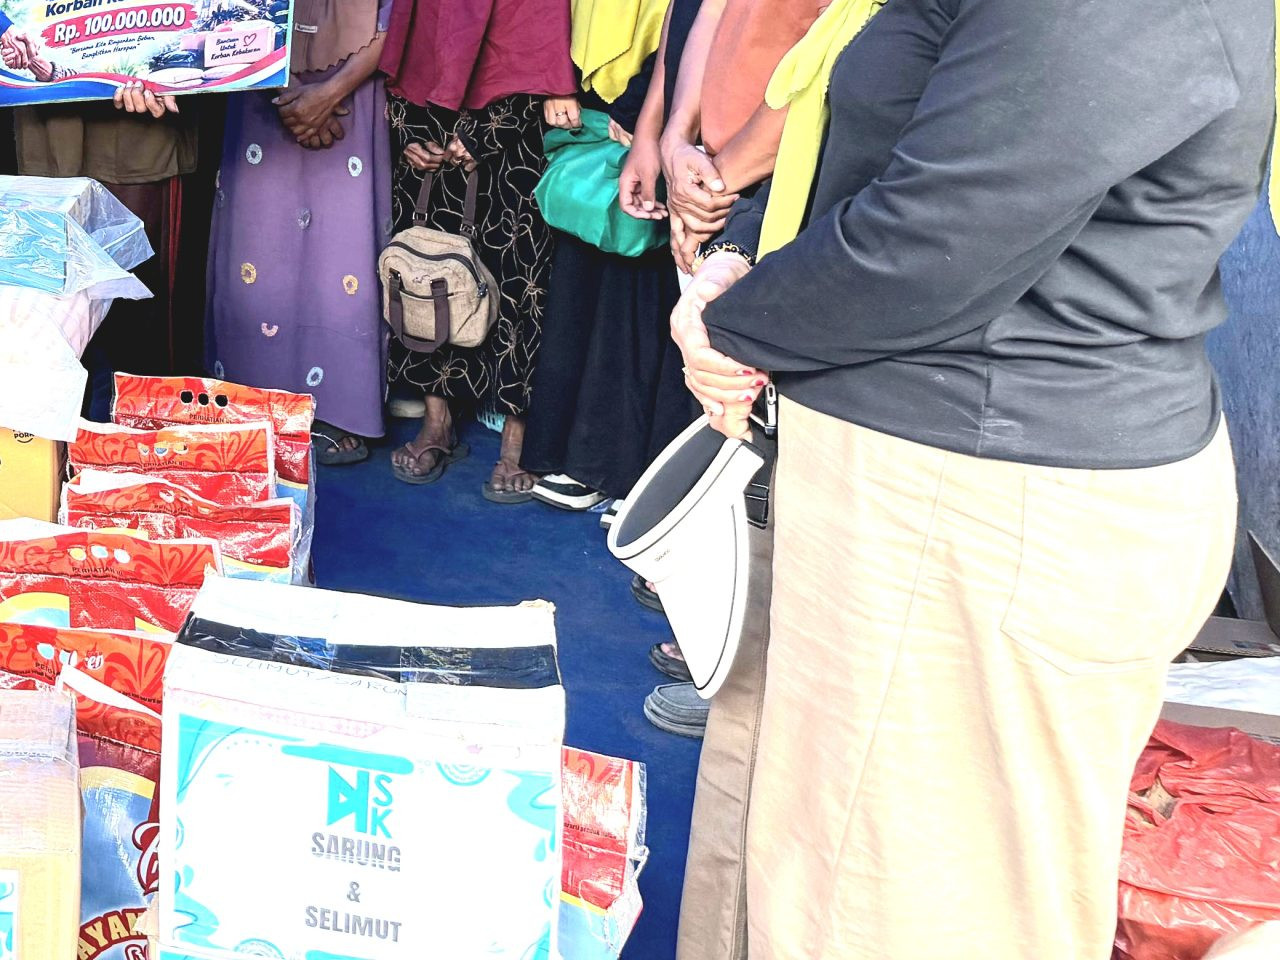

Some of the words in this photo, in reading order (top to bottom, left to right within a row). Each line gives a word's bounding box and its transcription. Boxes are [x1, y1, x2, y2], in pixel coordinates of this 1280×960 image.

[54, 23, 81, 44] Rp.
[84, 6, 186, 36] 100.000.000
[108, 36, 136, 46] Ringankan
[216, 36, 239, 46] Bantuan
[81, 48, 111, 59] Bangkitkan
[211, 52, 231, 60] Korban
[231, 47, 261, 56] Kebakaran
[220, 44, 236, 52] Untuk
[311, 831, 402, 873] SARUNG
[346, 881, 361, 903] &
[305, 905, 402, 943] SELIMUT
